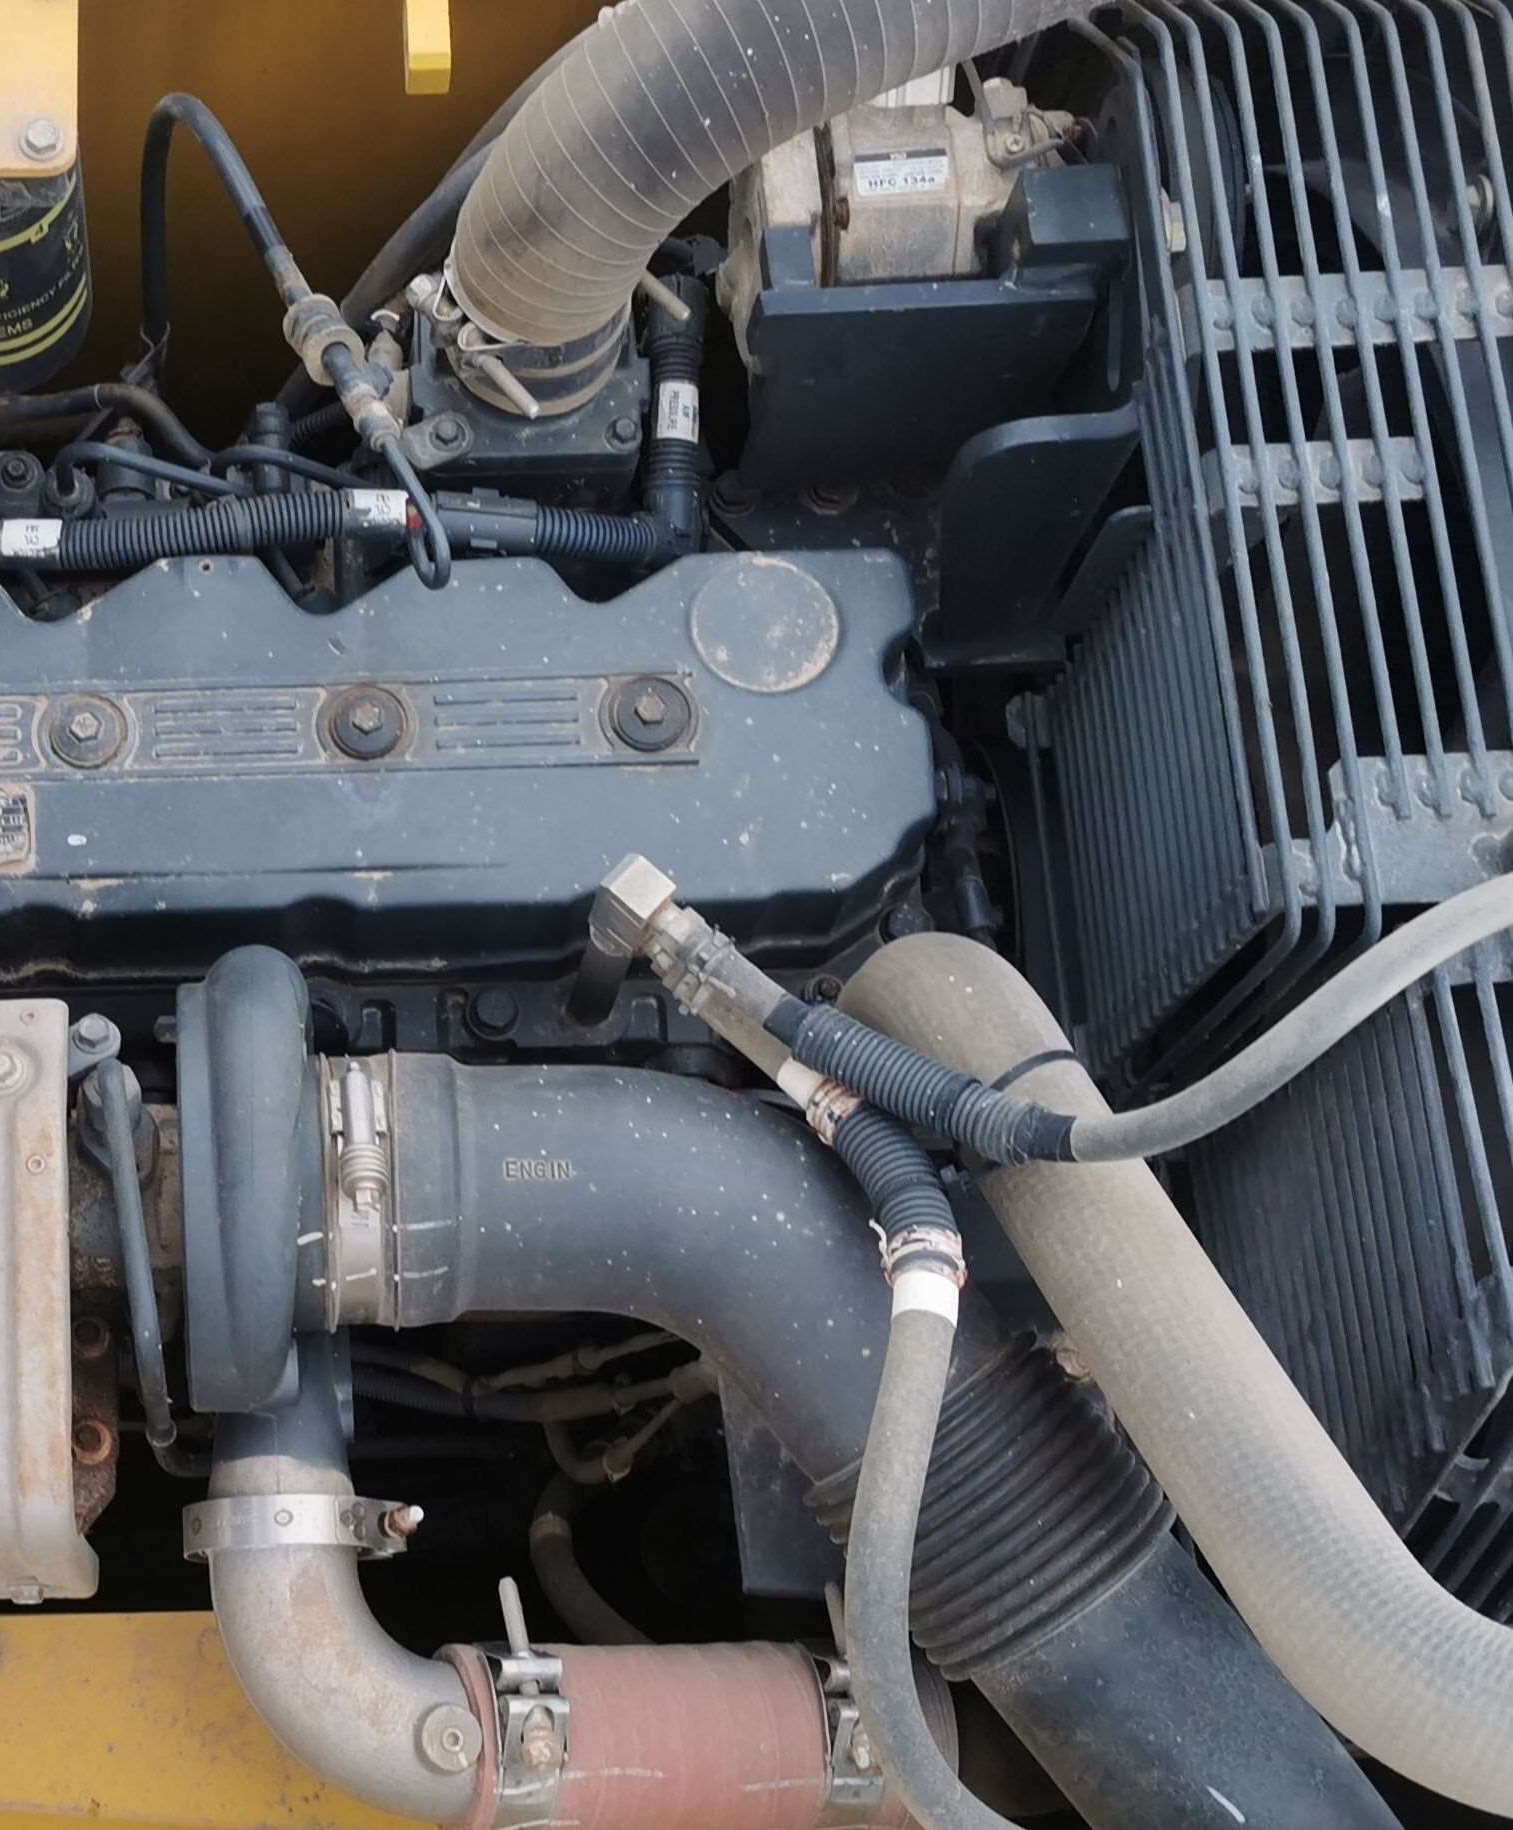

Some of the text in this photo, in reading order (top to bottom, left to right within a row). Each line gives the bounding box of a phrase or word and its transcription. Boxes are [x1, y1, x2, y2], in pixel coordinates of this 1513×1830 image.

[868, 175, 936, 190] HFC 134a
[504, 1158, 571, 1180] ENGIN
